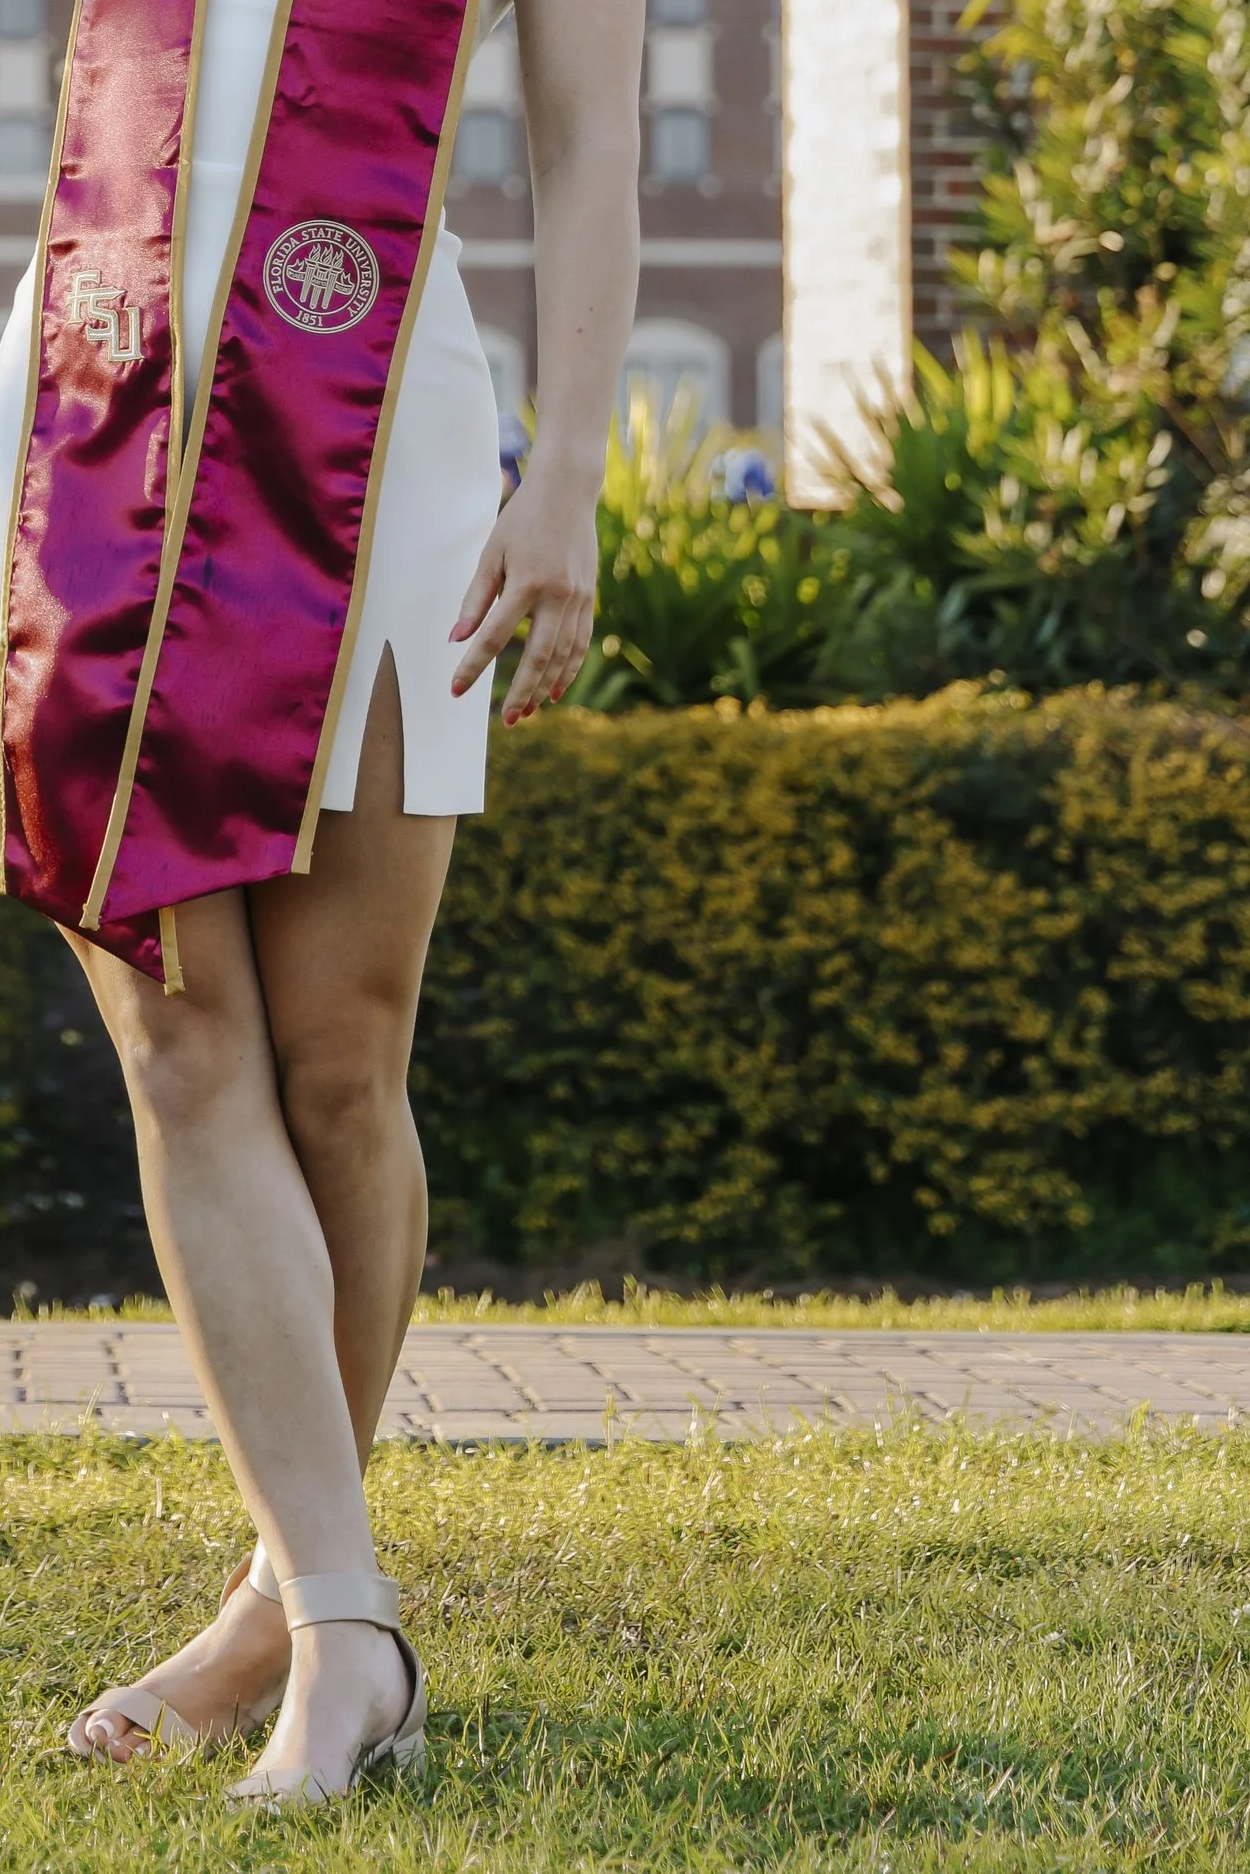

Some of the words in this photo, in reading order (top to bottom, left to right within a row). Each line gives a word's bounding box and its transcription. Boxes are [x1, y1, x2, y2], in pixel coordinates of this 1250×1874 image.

[65, 269, 145, 362] FSU
[270, 237, 300, 294] FLORIDA
[301, 228, 344, 242] STATE
[345, 237, 372, 317] UNIVERSITY
[295, 310, 323, 327] 1851
